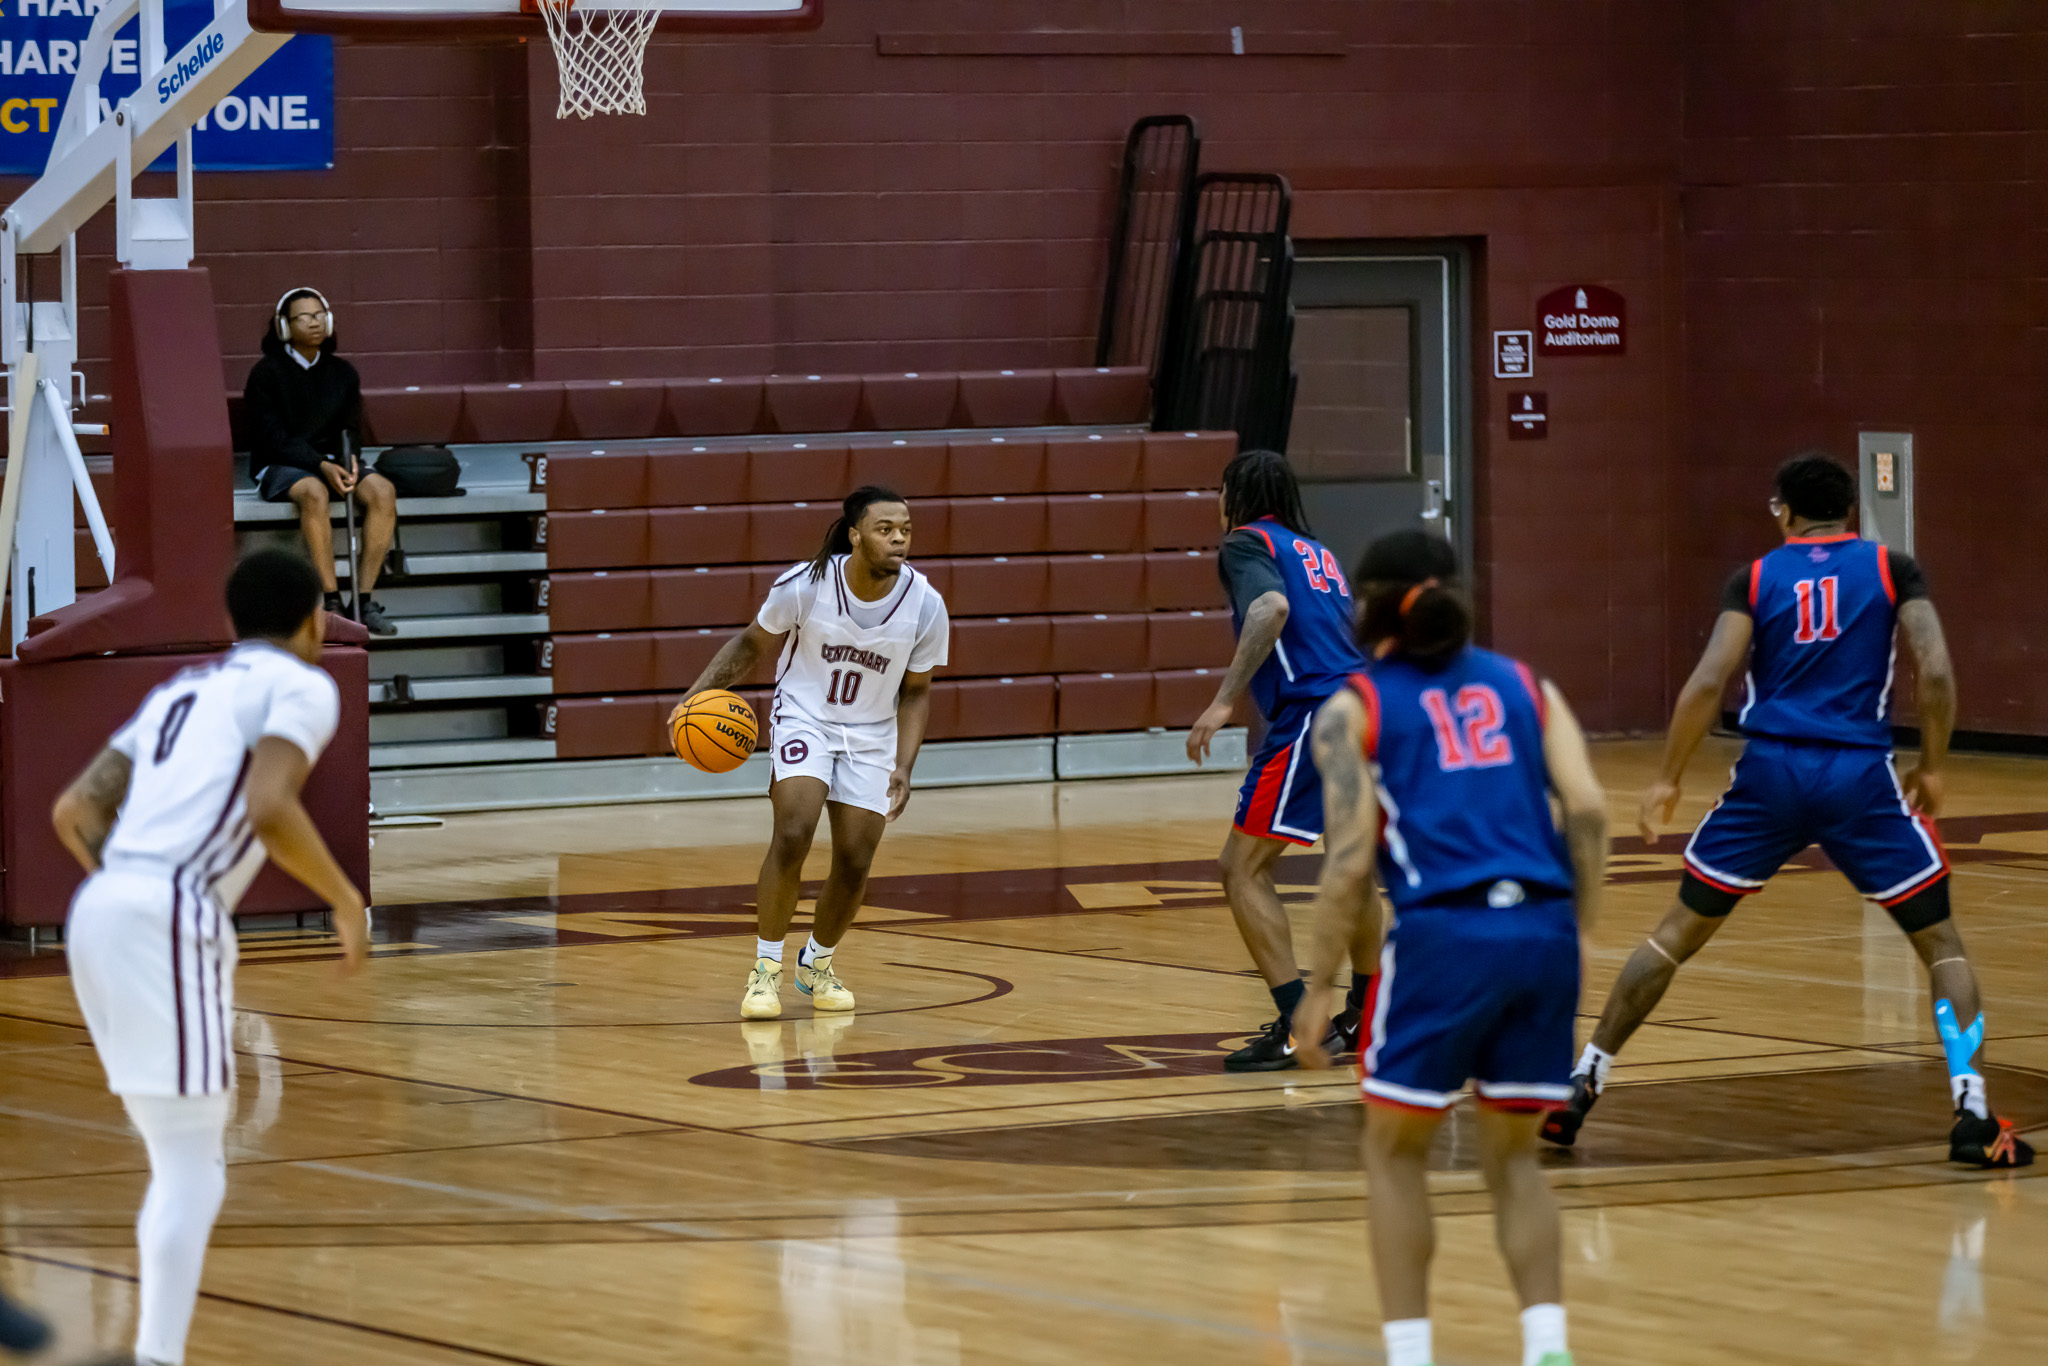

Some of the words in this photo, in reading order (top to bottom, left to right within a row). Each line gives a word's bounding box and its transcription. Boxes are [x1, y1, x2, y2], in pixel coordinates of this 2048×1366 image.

[158, 32, 225, 104] Schelde
[1545, 315, 1577, 329] Gold
[1580, 315, 1620, 328] Dome
[1545, 331, 1620, 346] Auditorium
[1292, 539, 1350, 597] 24
[1793, 575, 1843, 645] 11
[821, 643, 892, 676] CENTENARY
[826, 668, 864, 707] 10
[153, 690, 198, 767] 0
[716, 721, 755, 753] Wilson
[1420, 683, 1513, 772] 12
